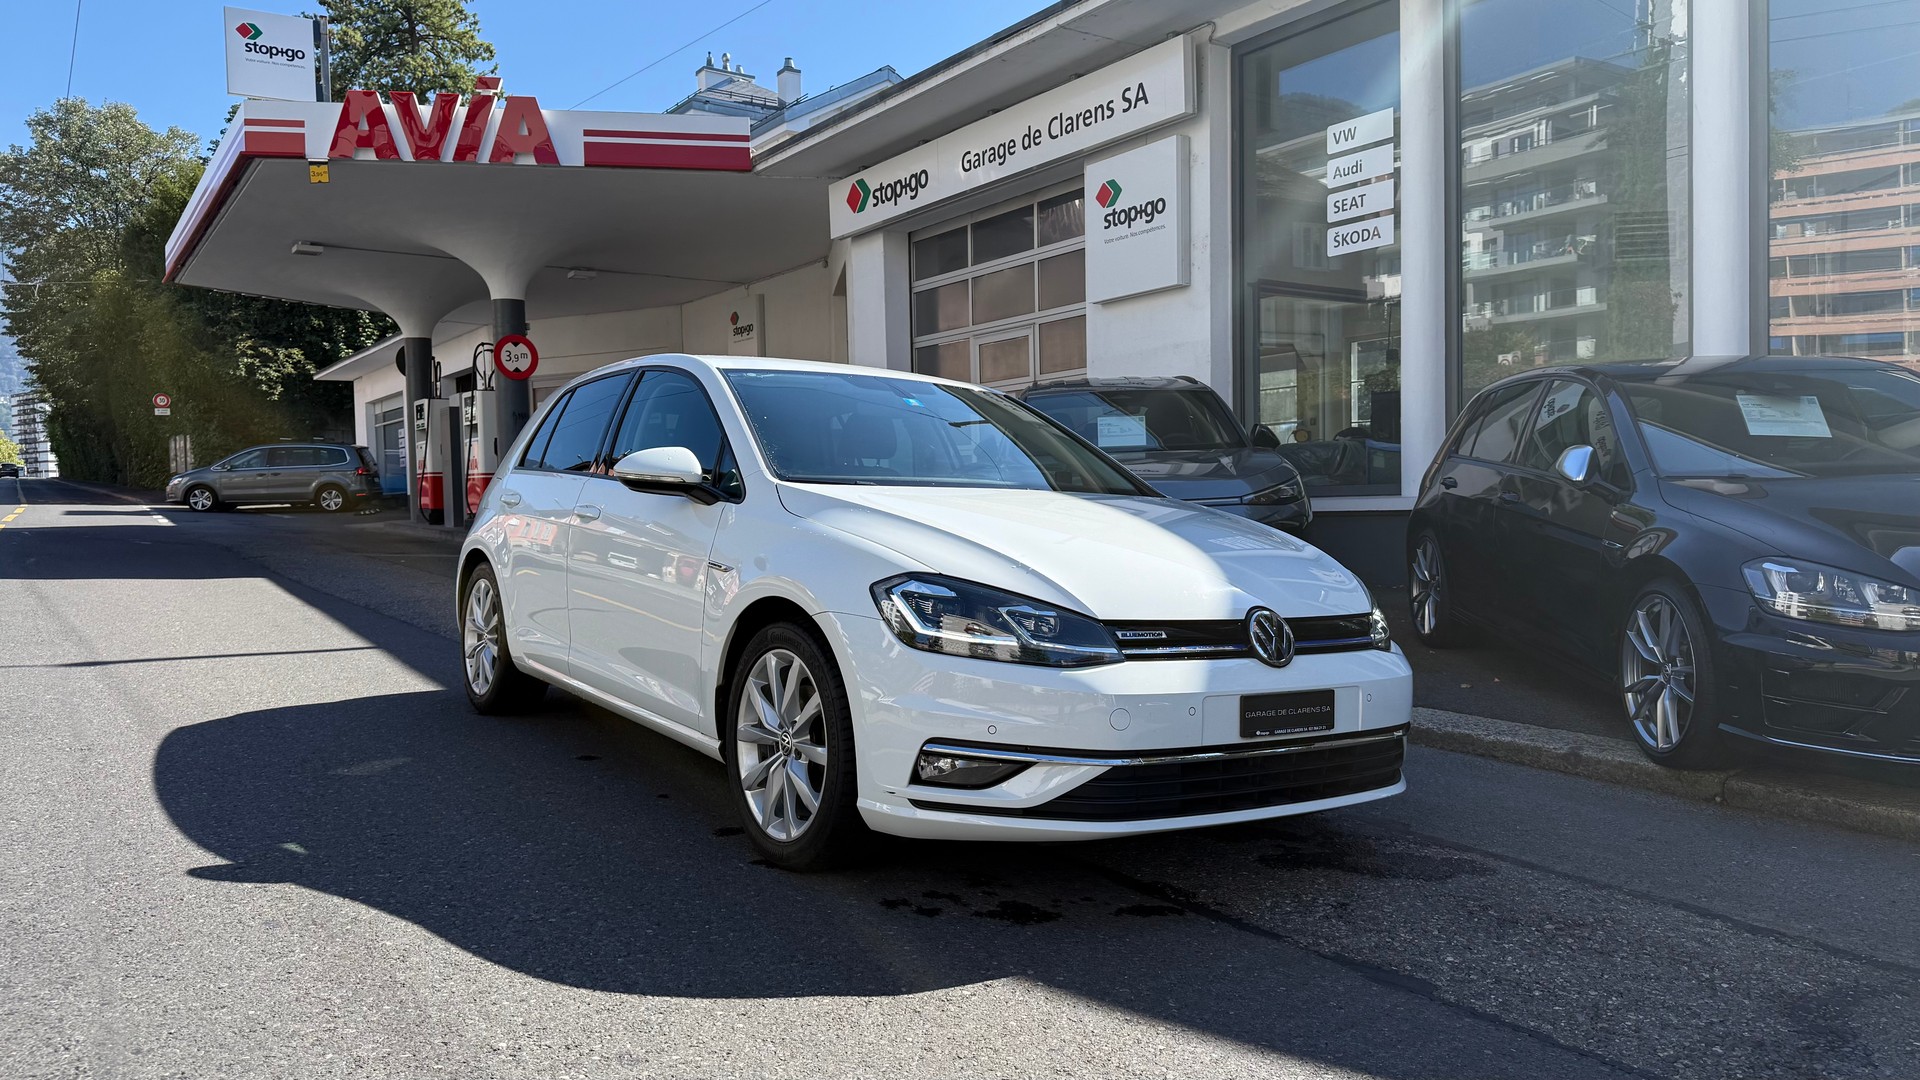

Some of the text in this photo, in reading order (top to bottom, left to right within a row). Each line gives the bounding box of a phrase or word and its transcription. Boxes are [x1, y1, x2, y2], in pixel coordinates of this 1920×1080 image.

[245, 41, 305, 62] stop+go
[961, 82, 1149, 173] Garage de Clarens SA
[1333, 126, 1357, 145] VW
[1333, 159, 1363, 180] Audi
[872, 169, 929, 207] stop+go
[1104, 197, 1166, 229] stop+go
[1333, 193, 1366, 214] SEAT
[1333, 226, 1381, 248] ŠKODA
[733, 323, 754, 337] stop+go
[1245, 709, 1276, 718] GARAGE
[1288, 706, 1320, 715] CLARENS
